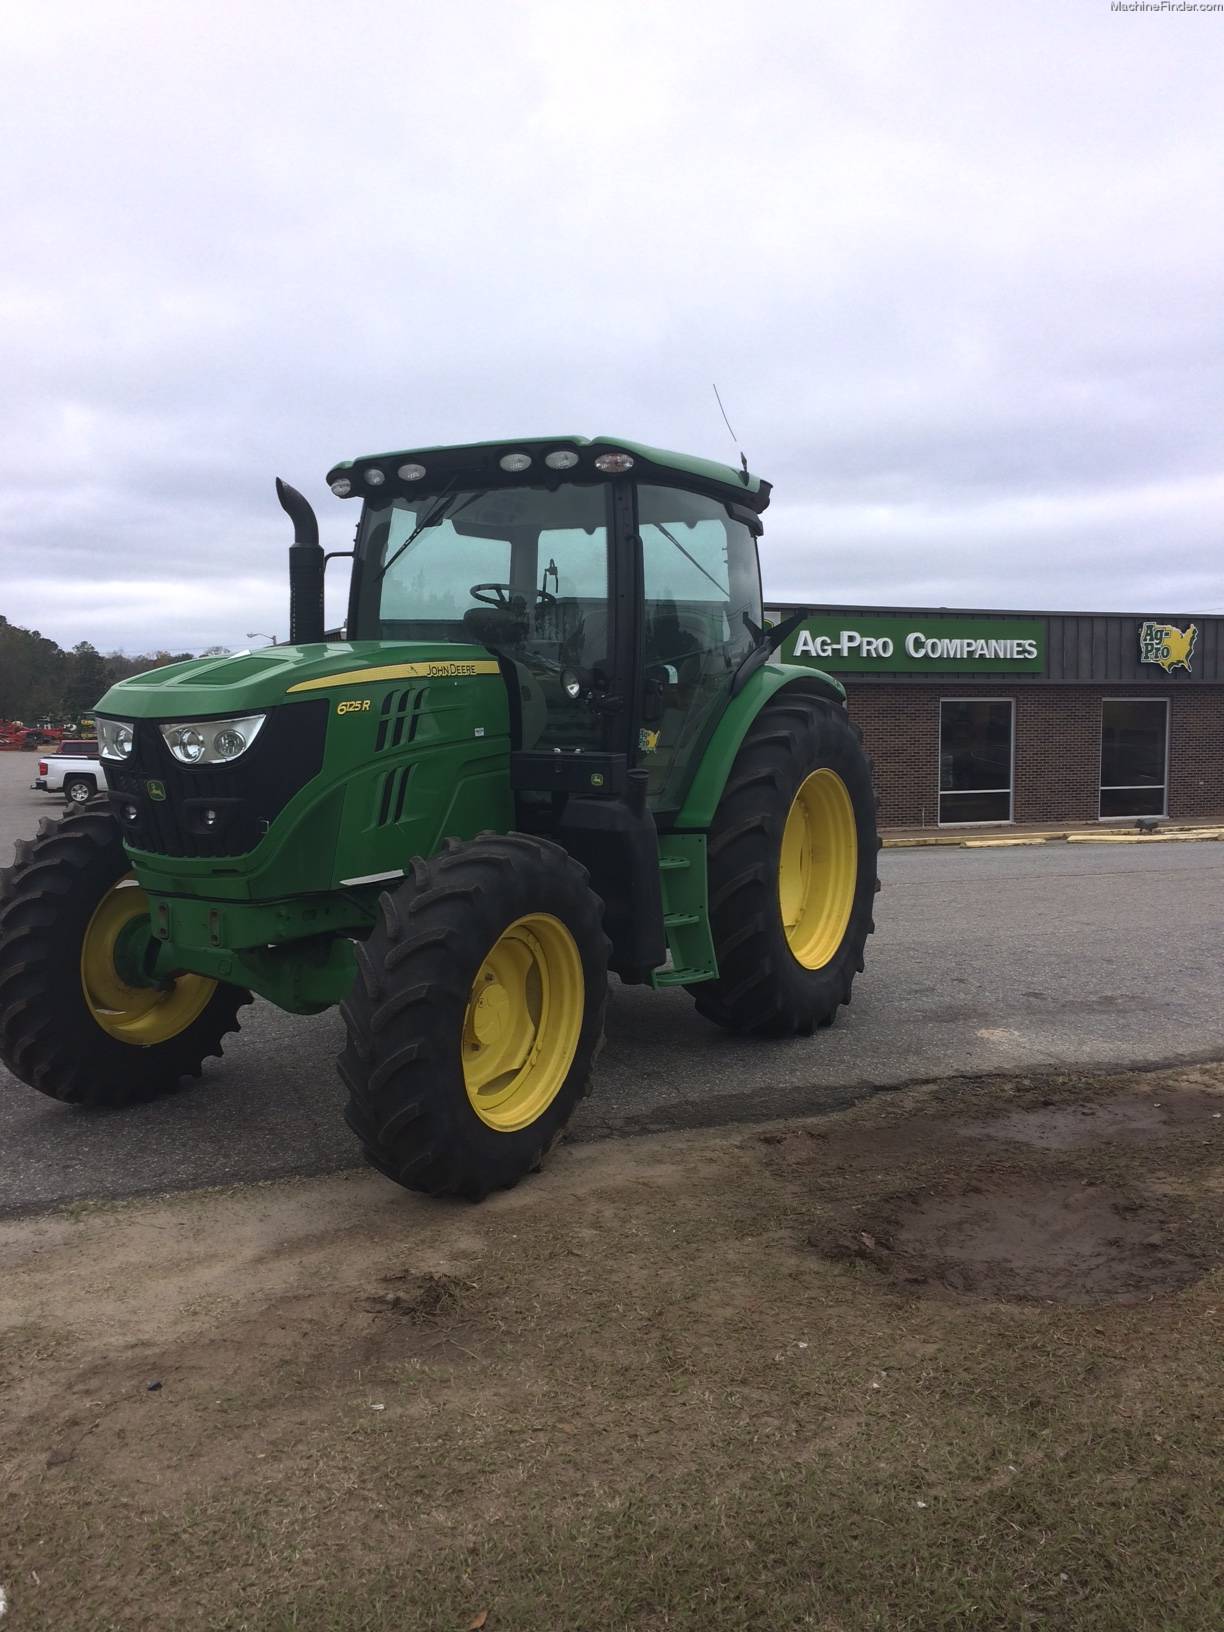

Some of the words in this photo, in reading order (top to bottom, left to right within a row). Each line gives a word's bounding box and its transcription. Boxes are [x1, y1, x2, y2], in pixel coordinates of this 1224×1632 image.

[1143, 624, 1170, 645] Ag-
[793, 630, 894, 657] AG-PRO
[905, 632, 1038, 659] COMPANIES
[1143, 642, 1170, 660] Pro
[426, 664, 450, 676] JOHN
[450, 664, 476, 675] DEERE
